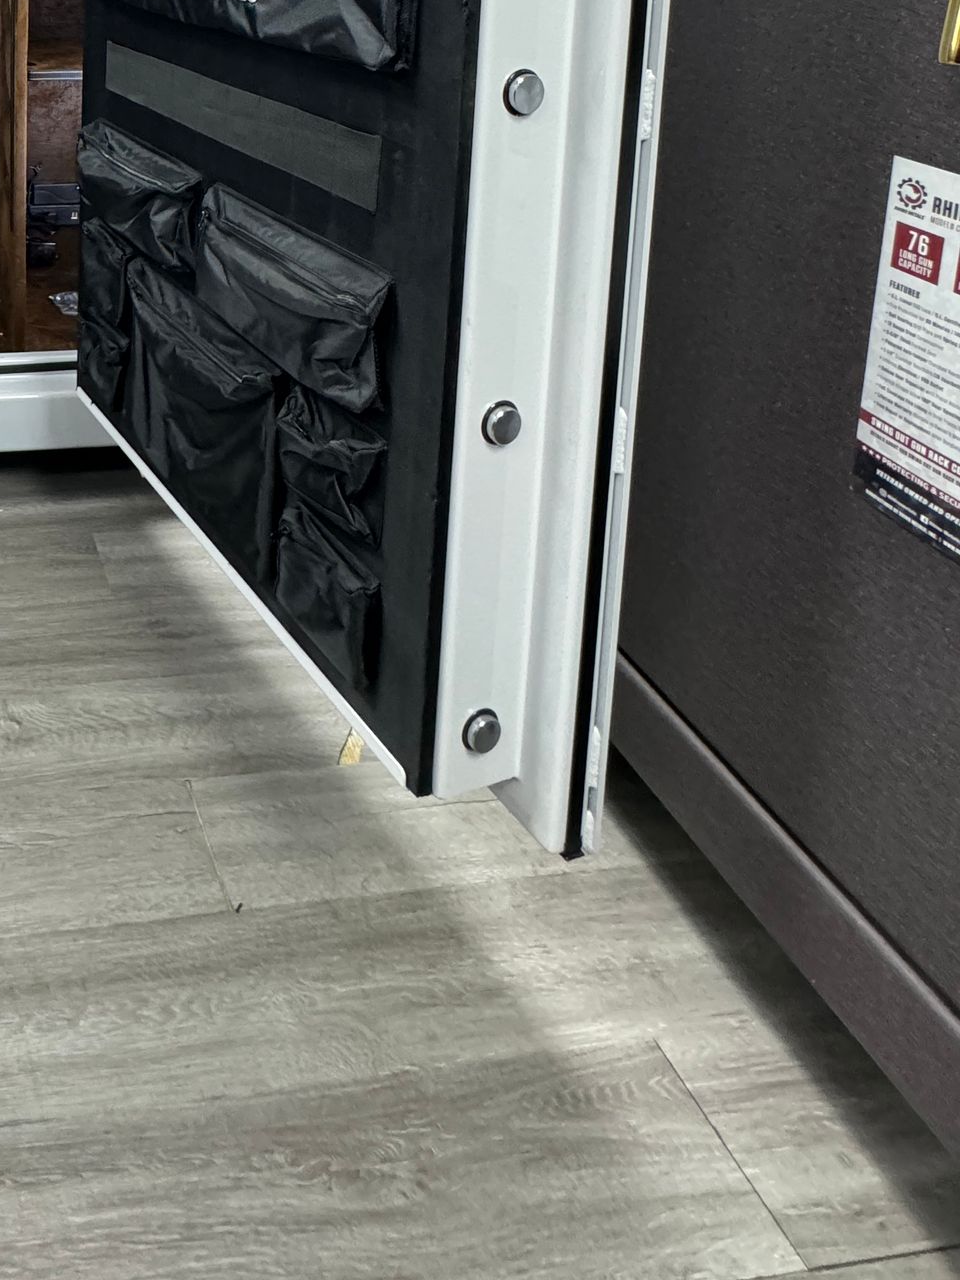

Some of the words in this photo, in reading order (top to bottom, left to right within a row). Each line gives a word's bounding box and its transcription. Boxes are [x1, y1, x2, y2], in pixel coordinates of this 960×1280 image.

[931, 196, 960, 221] RHI
[908, 230, 930, 256] 76
[898, 257, 932, 278] CAPACITY
[899, 249, 917, 263] LONG
[918, 255, 934, 269] GUN
[889, 279, 921, 299] FEATURES
[870, 416, 894, 437] SWING
[894, 430, 910, 446] OUT
[910, 439, 927, 456] GUN
[928, 449, 951, 469] RACK
[876, 468, 904, 490] VETERAN
[903, 486, 929, 505] OWNED
[928, 502, 945, 515] AND
[881, 456, 930, 491] PROTECTING
[938, 491, 960, 509] SECU
